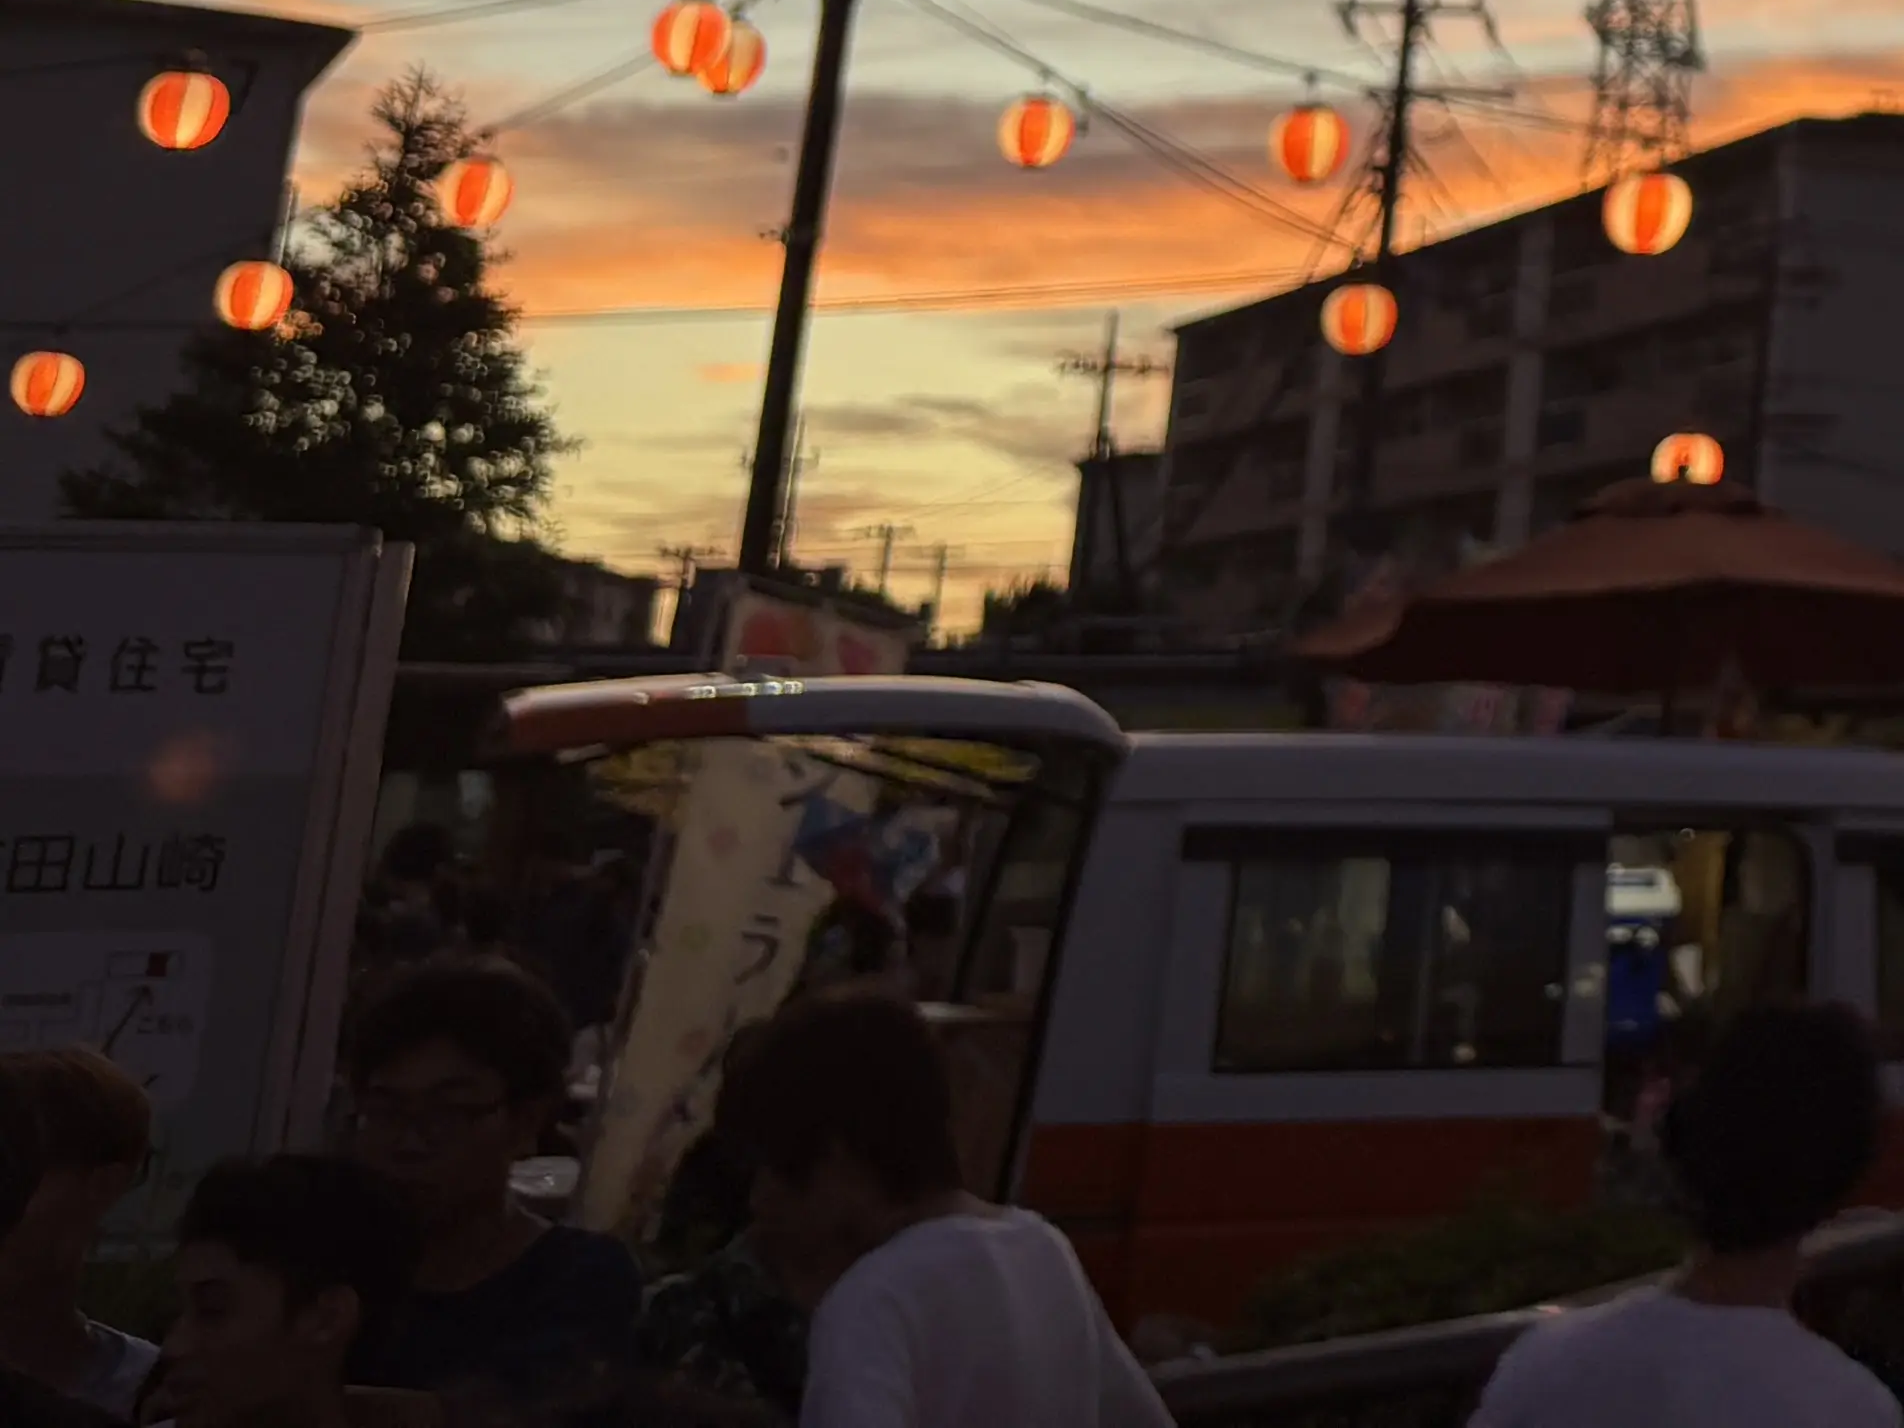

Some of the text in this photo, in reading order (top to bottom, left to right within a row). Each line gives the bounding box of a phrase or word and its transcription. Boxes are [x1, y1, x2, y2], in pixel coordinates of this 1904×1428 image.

[0, 633, 235, 695] 貸住宅
[0, 830, 227, 893] 田山崎
